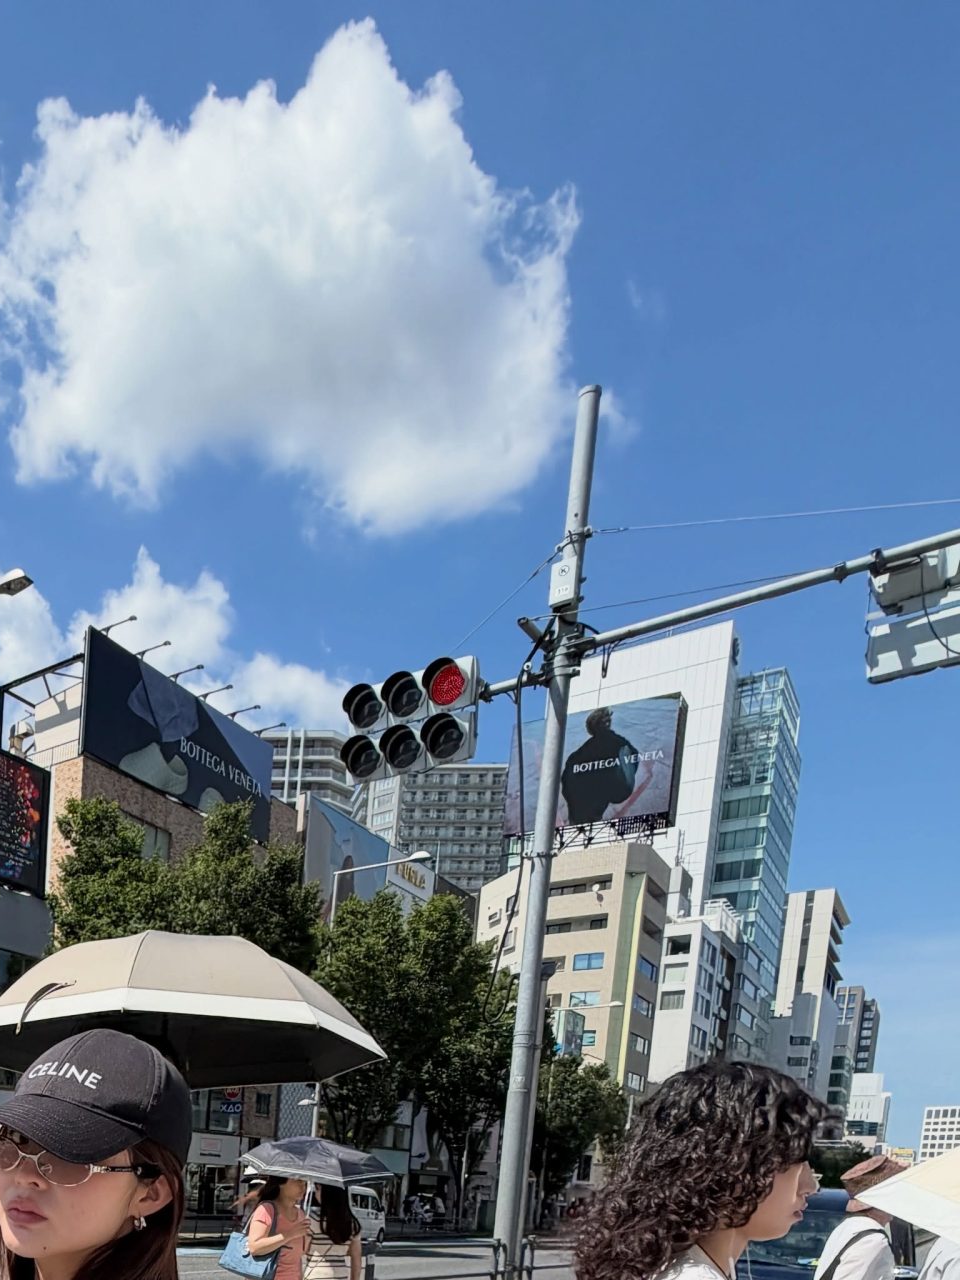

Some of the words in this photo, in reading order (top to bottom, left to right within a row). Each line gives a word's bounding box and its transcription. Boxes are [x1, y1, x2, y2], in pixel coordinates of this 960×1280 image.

[180, 736, 226, 777] BOTTEGA
[228, 763, 262, 797] VENETA
[573, 757, 620, 773] BOTTEGA
[623, 749, 664, 765] VENETA
[28, 1061, 103, 1090] CELINE
